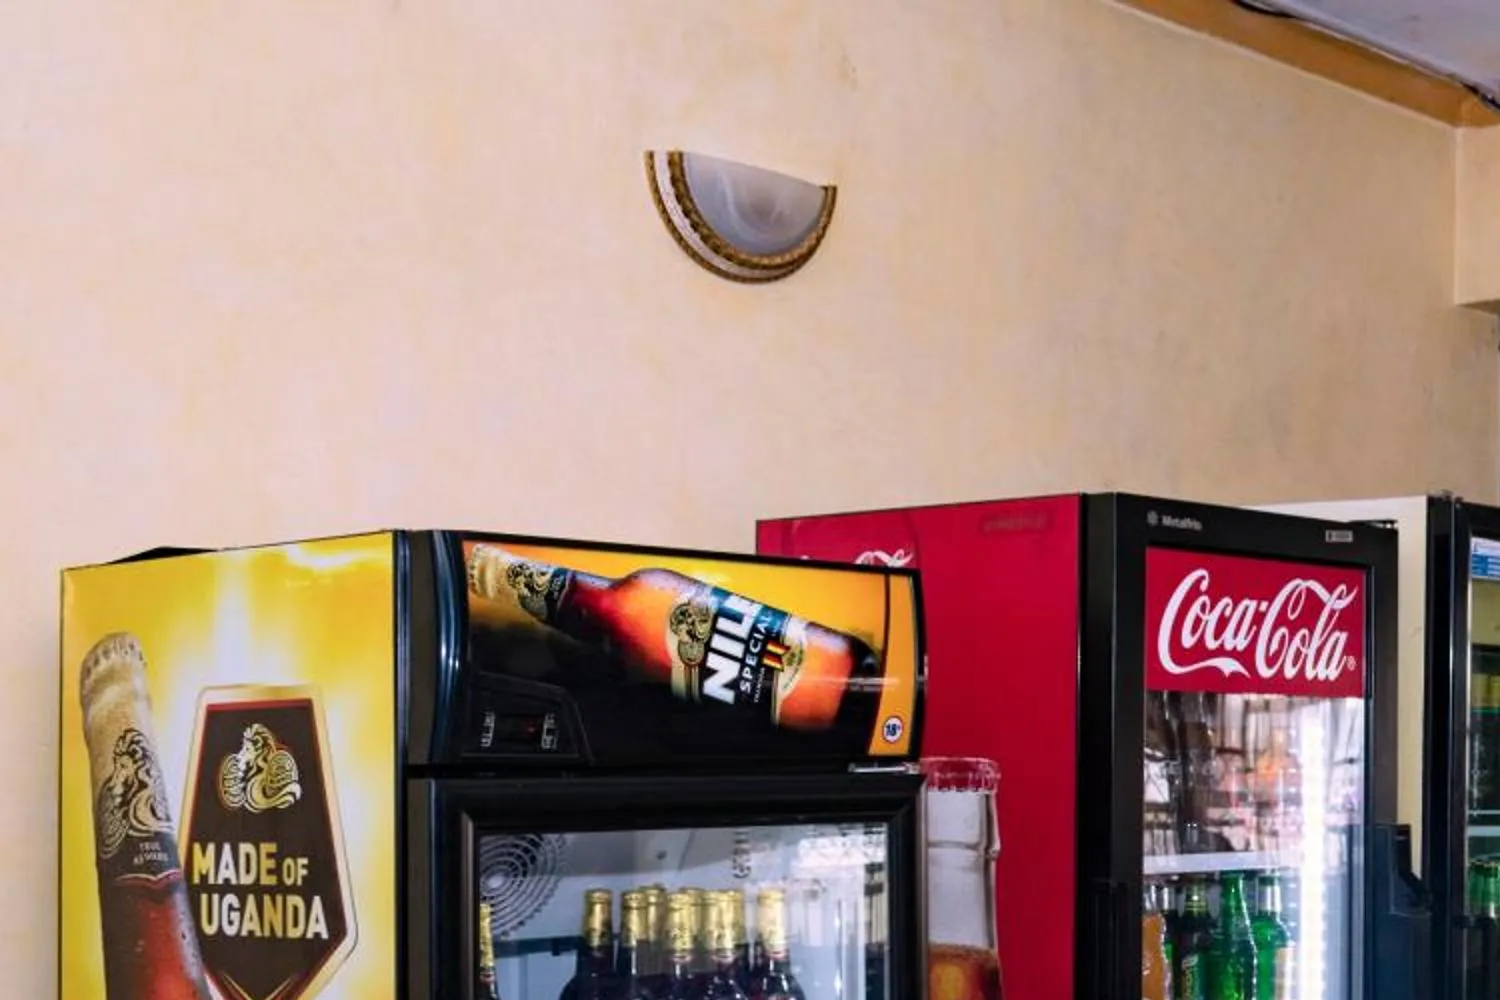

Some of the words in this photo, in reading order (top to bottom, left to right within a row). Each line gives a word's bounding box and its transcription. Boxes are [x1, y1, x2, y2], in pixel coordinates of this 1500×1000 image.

[1157, 568, 1358, 681] Coca-Cola
[192, 841, 278, 886] MADE
[283, 857, 308, 884] OF
[201, 893, 329, 940] UGANDA
